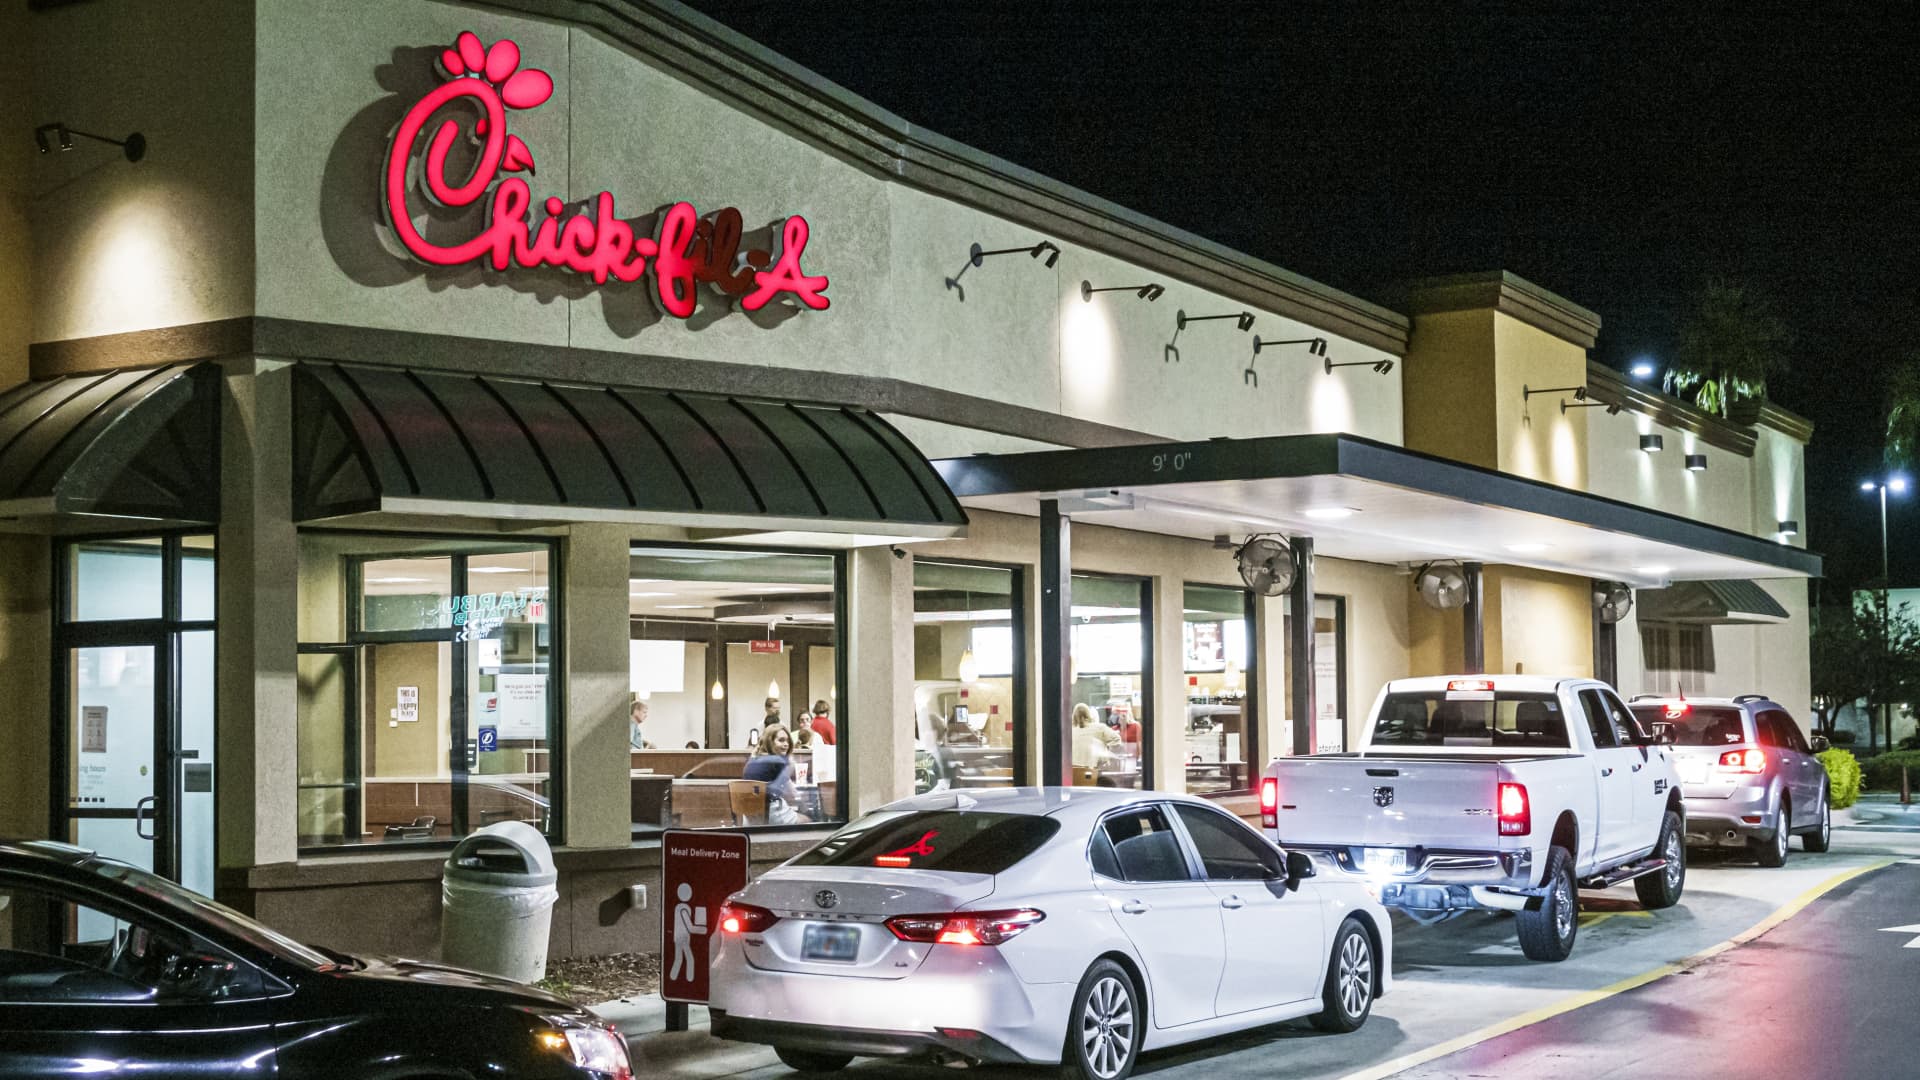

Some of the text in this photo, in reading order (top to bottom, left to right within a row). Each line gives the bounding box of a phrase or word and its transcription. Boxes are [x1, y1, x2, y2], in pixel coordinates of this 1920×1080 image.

[386, 76, 830, 319] Chick-fil-A
[1152, 451, 1191, 472] 9' 0"
[671, 847, 740, 860] Meal Delivery Zone
